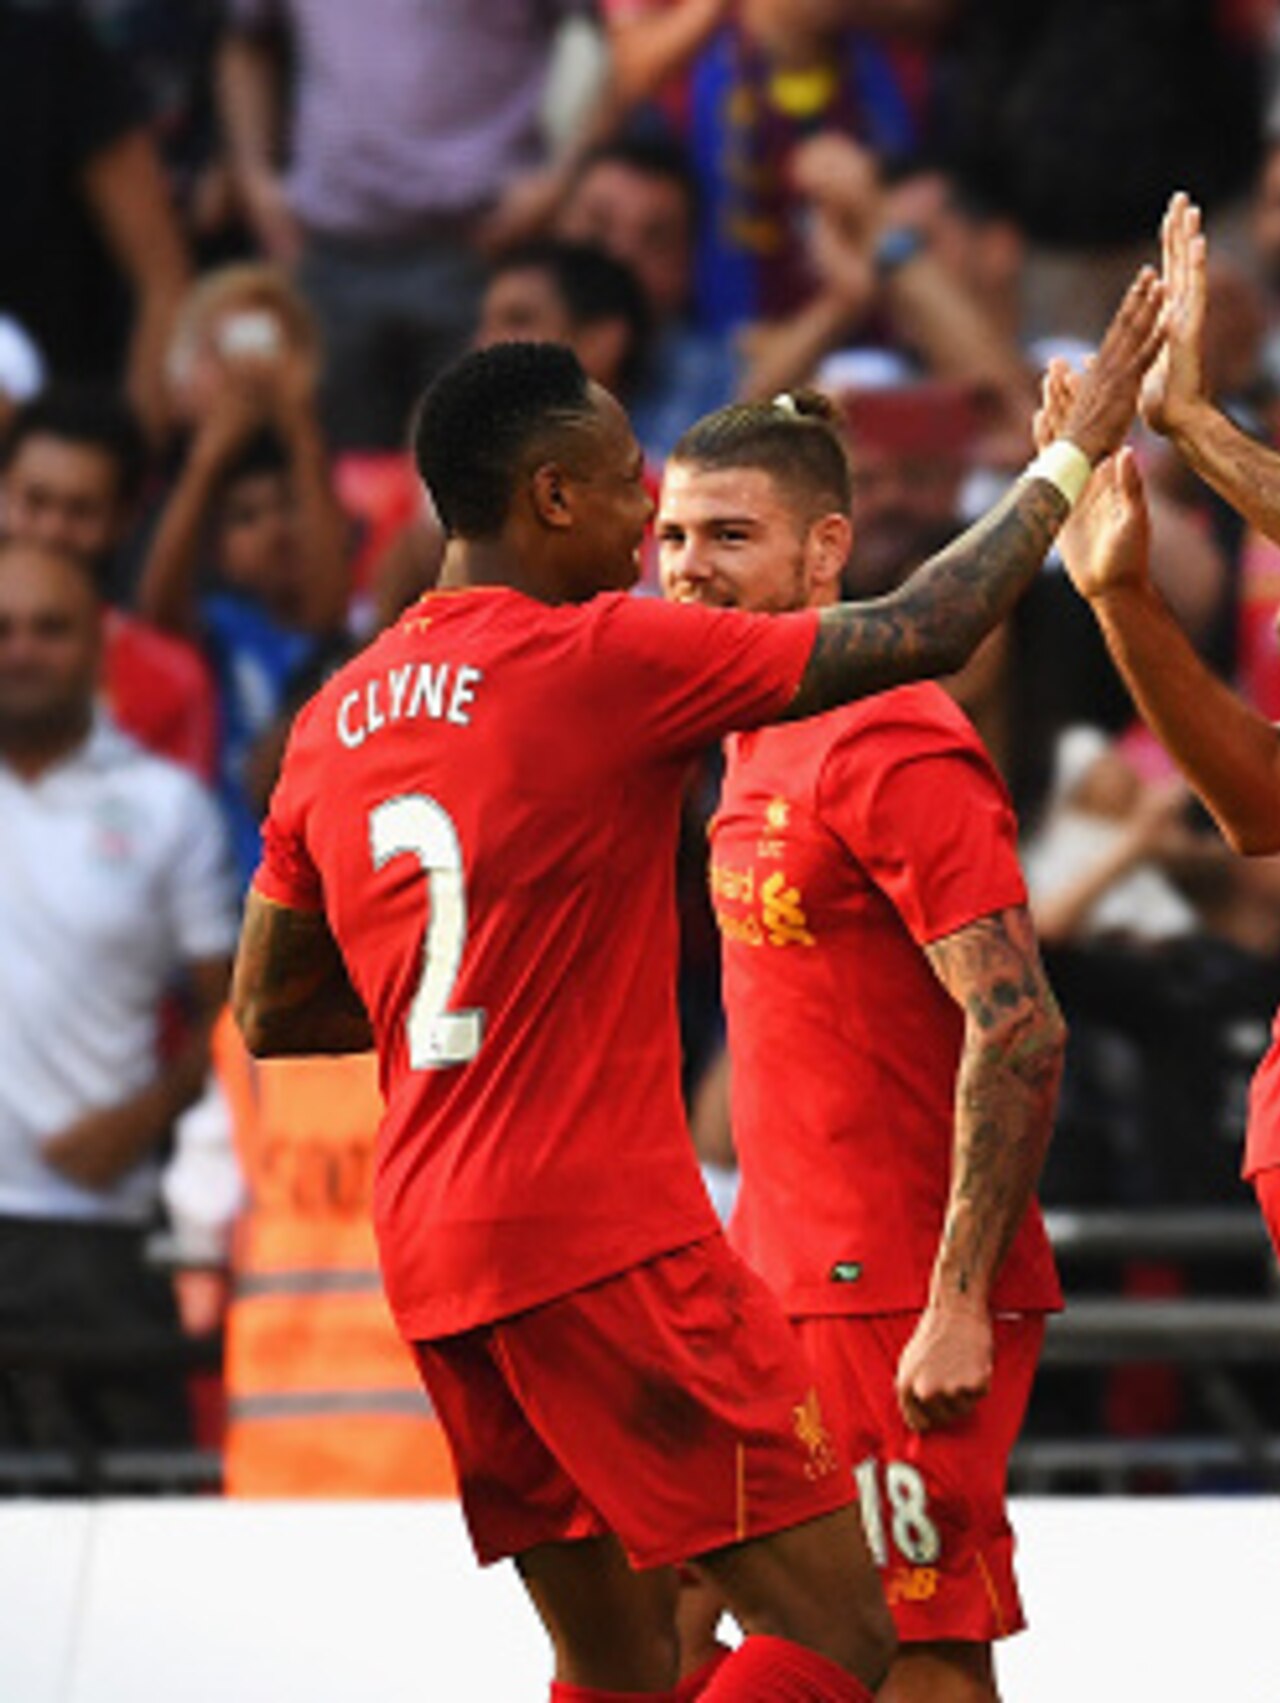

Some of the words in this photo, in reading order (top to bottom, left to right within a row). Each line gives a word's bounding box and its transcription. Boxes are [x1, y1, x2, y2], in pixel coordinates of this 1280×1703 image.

[337, 662, 483, 749] CLYNE
[368, 791, 486, 1071] 2
[853, 1455, 940, 1569] 18
